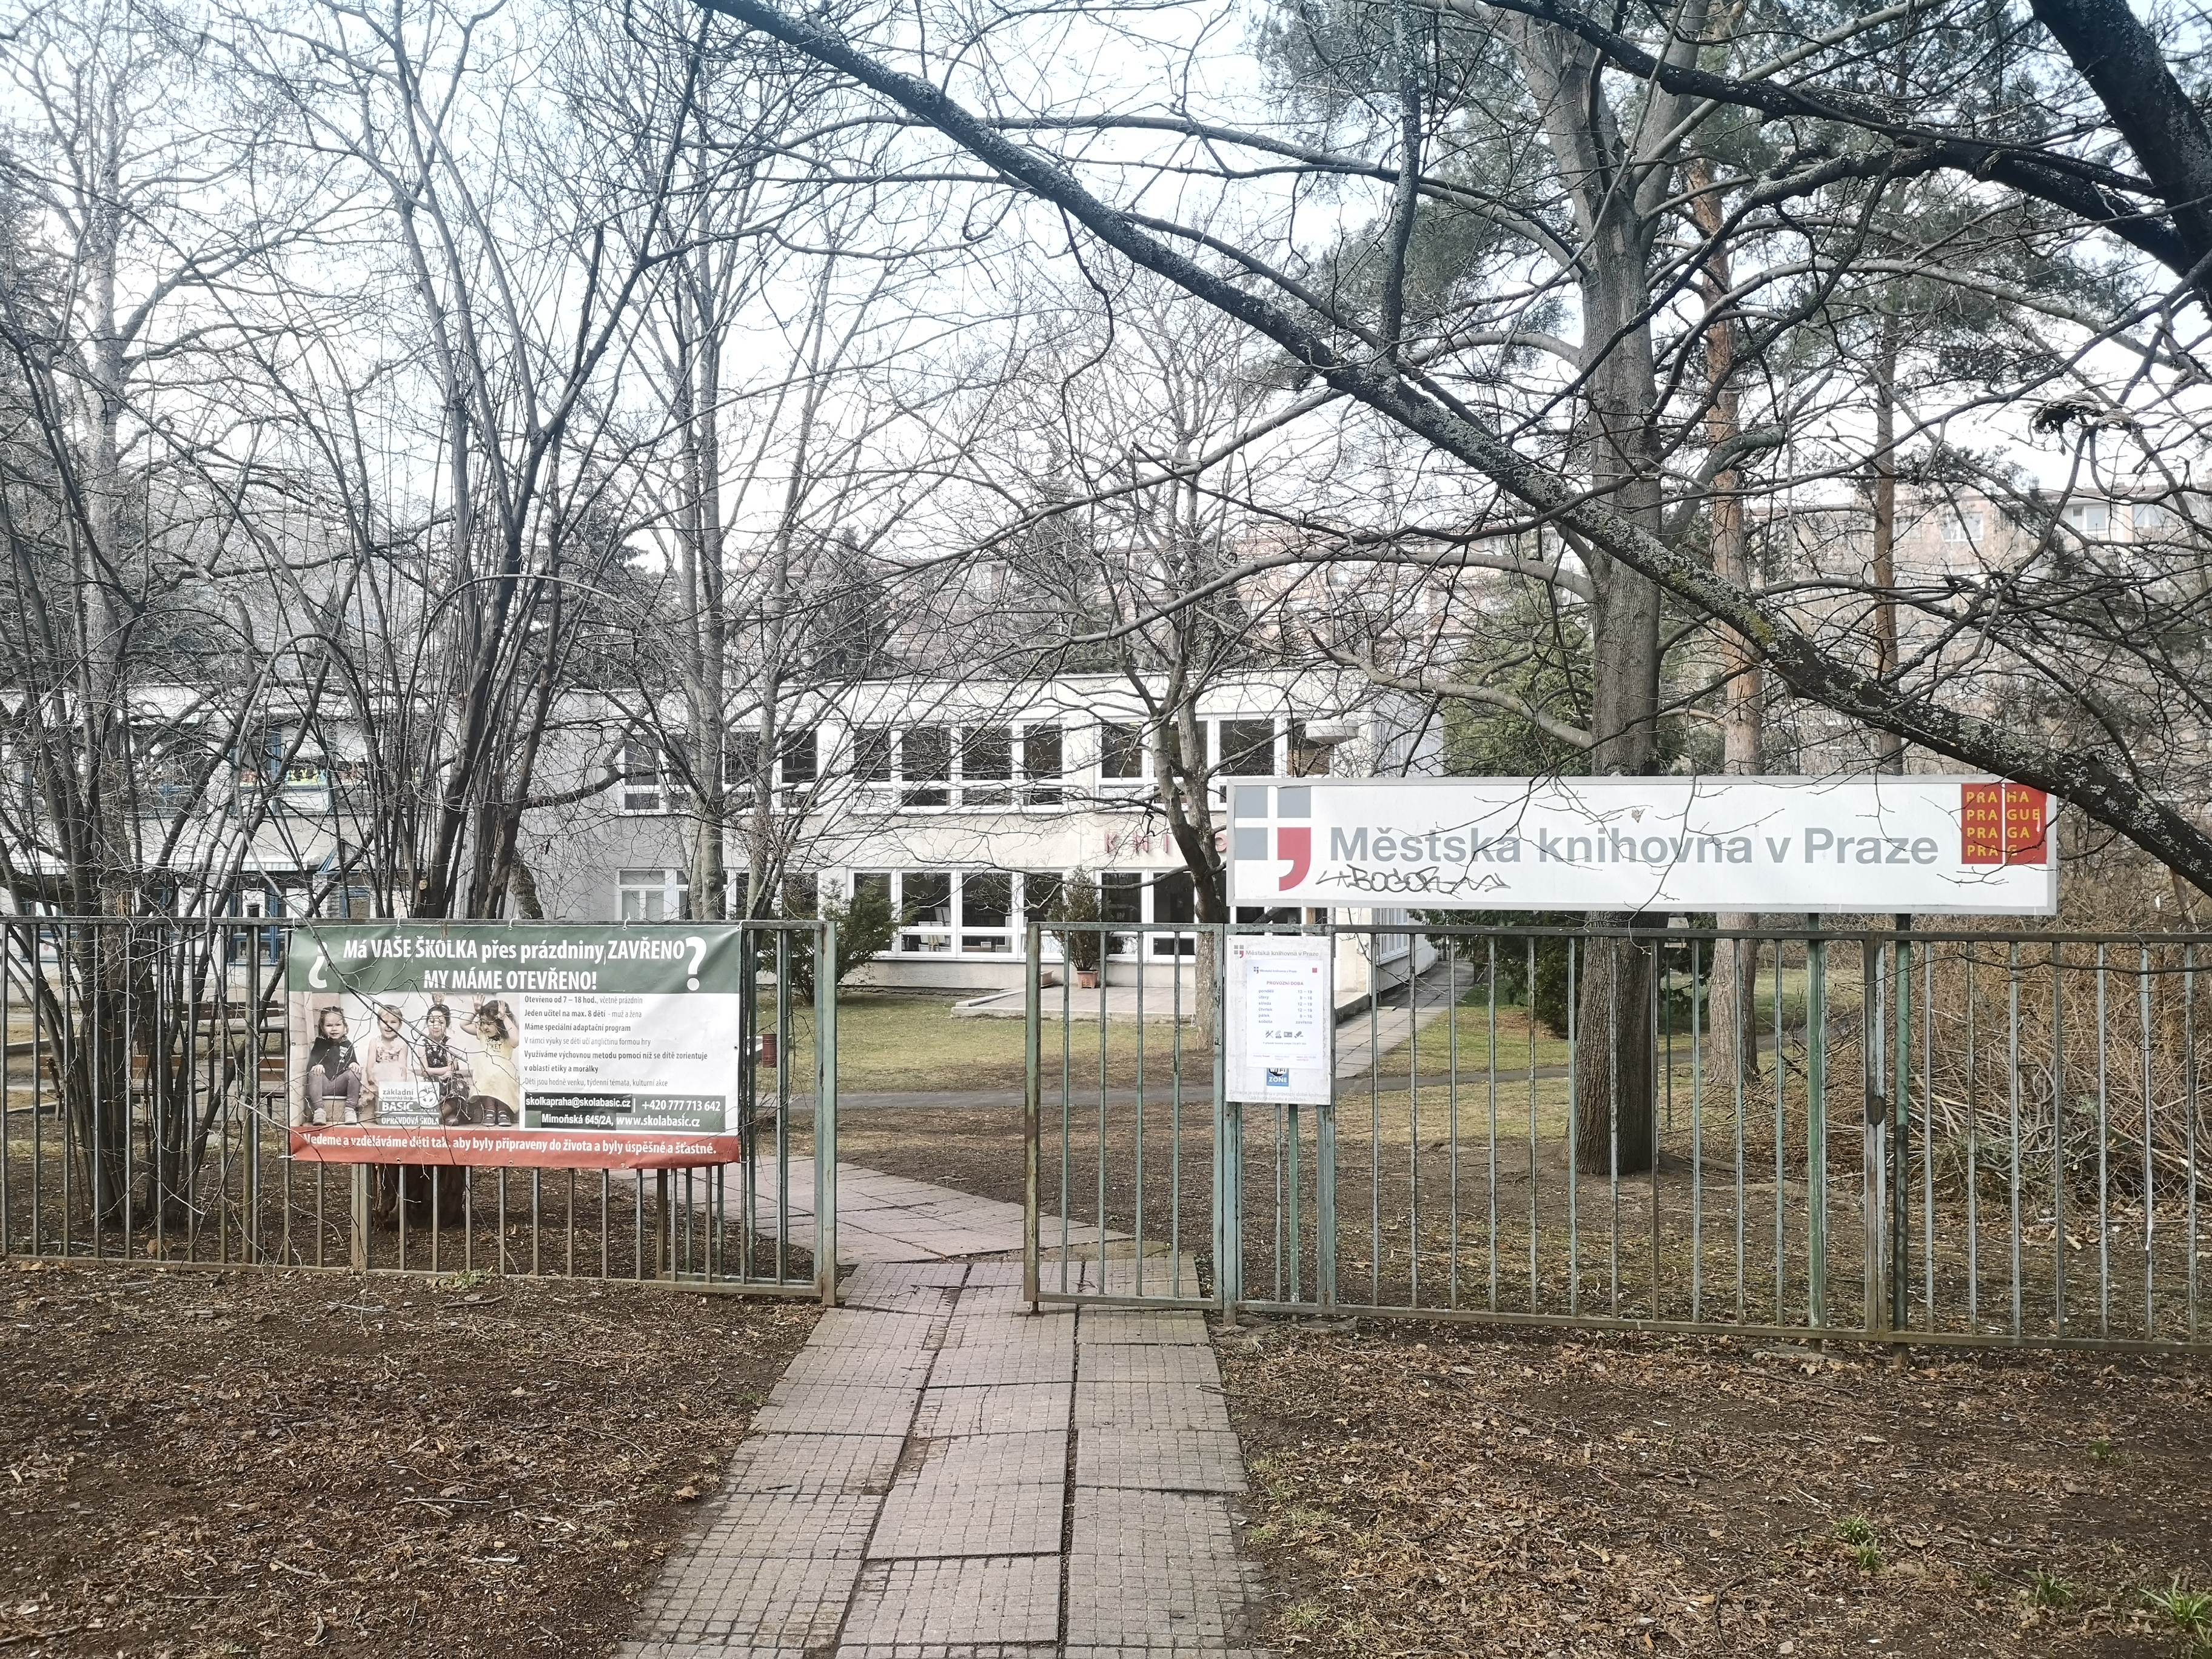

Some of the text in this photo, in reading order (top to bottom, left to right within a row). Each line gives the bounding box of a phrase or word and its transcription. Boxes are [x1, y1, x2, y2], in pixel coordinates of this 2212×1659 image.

[1330, 826, 1938, 865] Městská knihovna v Praze
[343, 939, 367, 958] Má
[371, 936, 411, 958] VAŠE
[415, 936, 478, 958] ŠKOLKA
[482, 939, 516, 963] přes
[608, 937, 685, 959] ZAVŘENO
[424, 967, 597, 990] MY MÁME OTEVŘENO!
[619, 996, 643, 1005] prázdnin
[545, 1023, 572, 1032] speciální
[573, 1024, 604, 1033] adaptační
[546, 1037, 562, 1046] výuky
[591, 1037, 618, 1047] angličtinu
[642, 1039, 651, 1047] hry
[525, 1050, 558, 1060] Využíváme
[558, 1050, 591, 1060] výchovnou
[618, 1051, 642, 1060] pomocí
[676, 1052, 708, 1061] zorientuje
[551, 1065, 567, 1073] etiky
[573, 1065, 598, 1074] morálky
[537, 1078, 548, 1087] jsou
[587, 1078, 609, 1087] týdenní
[609, 1079, 631, 1087] témata,
[382, 1102, 414, 1111] BASIC
[526, 1096, 631, 1108] skolkapraha@skolabasic.cz
[642, 1099, 666, 1111] +420
[668, 1100, 685, 1111] 777
[686, 1100, 702, 1111] 713
[703, 1101, 721, 1112] 642
[541, 1113, 700, 1127] Mimoňská 645/2A, www.skolabasic.cz
[304, 1133, 341, 1145] Vedeme
[343, 1138, 349, 1146] a
[350, 1135, 407, 1147] vzděláváme
[409, 1135, 429, 1147] děti
[453, 1136, 471, 1151] aby
[473, 1137, 494, 1151] byly
[496, 1138, 548, 1152] připraveny
[549, 1139, 561, 1151] do
[563, 1138, 592, 1151] života
[594, 1142, 600, 1151] a
[603, 1139, 623, 1154] byly
[625, 1139, 666, 1155] úspěšné
[668, 1144, 673, 1153] a
[675, 1141, 717, 1155] šťastné.
